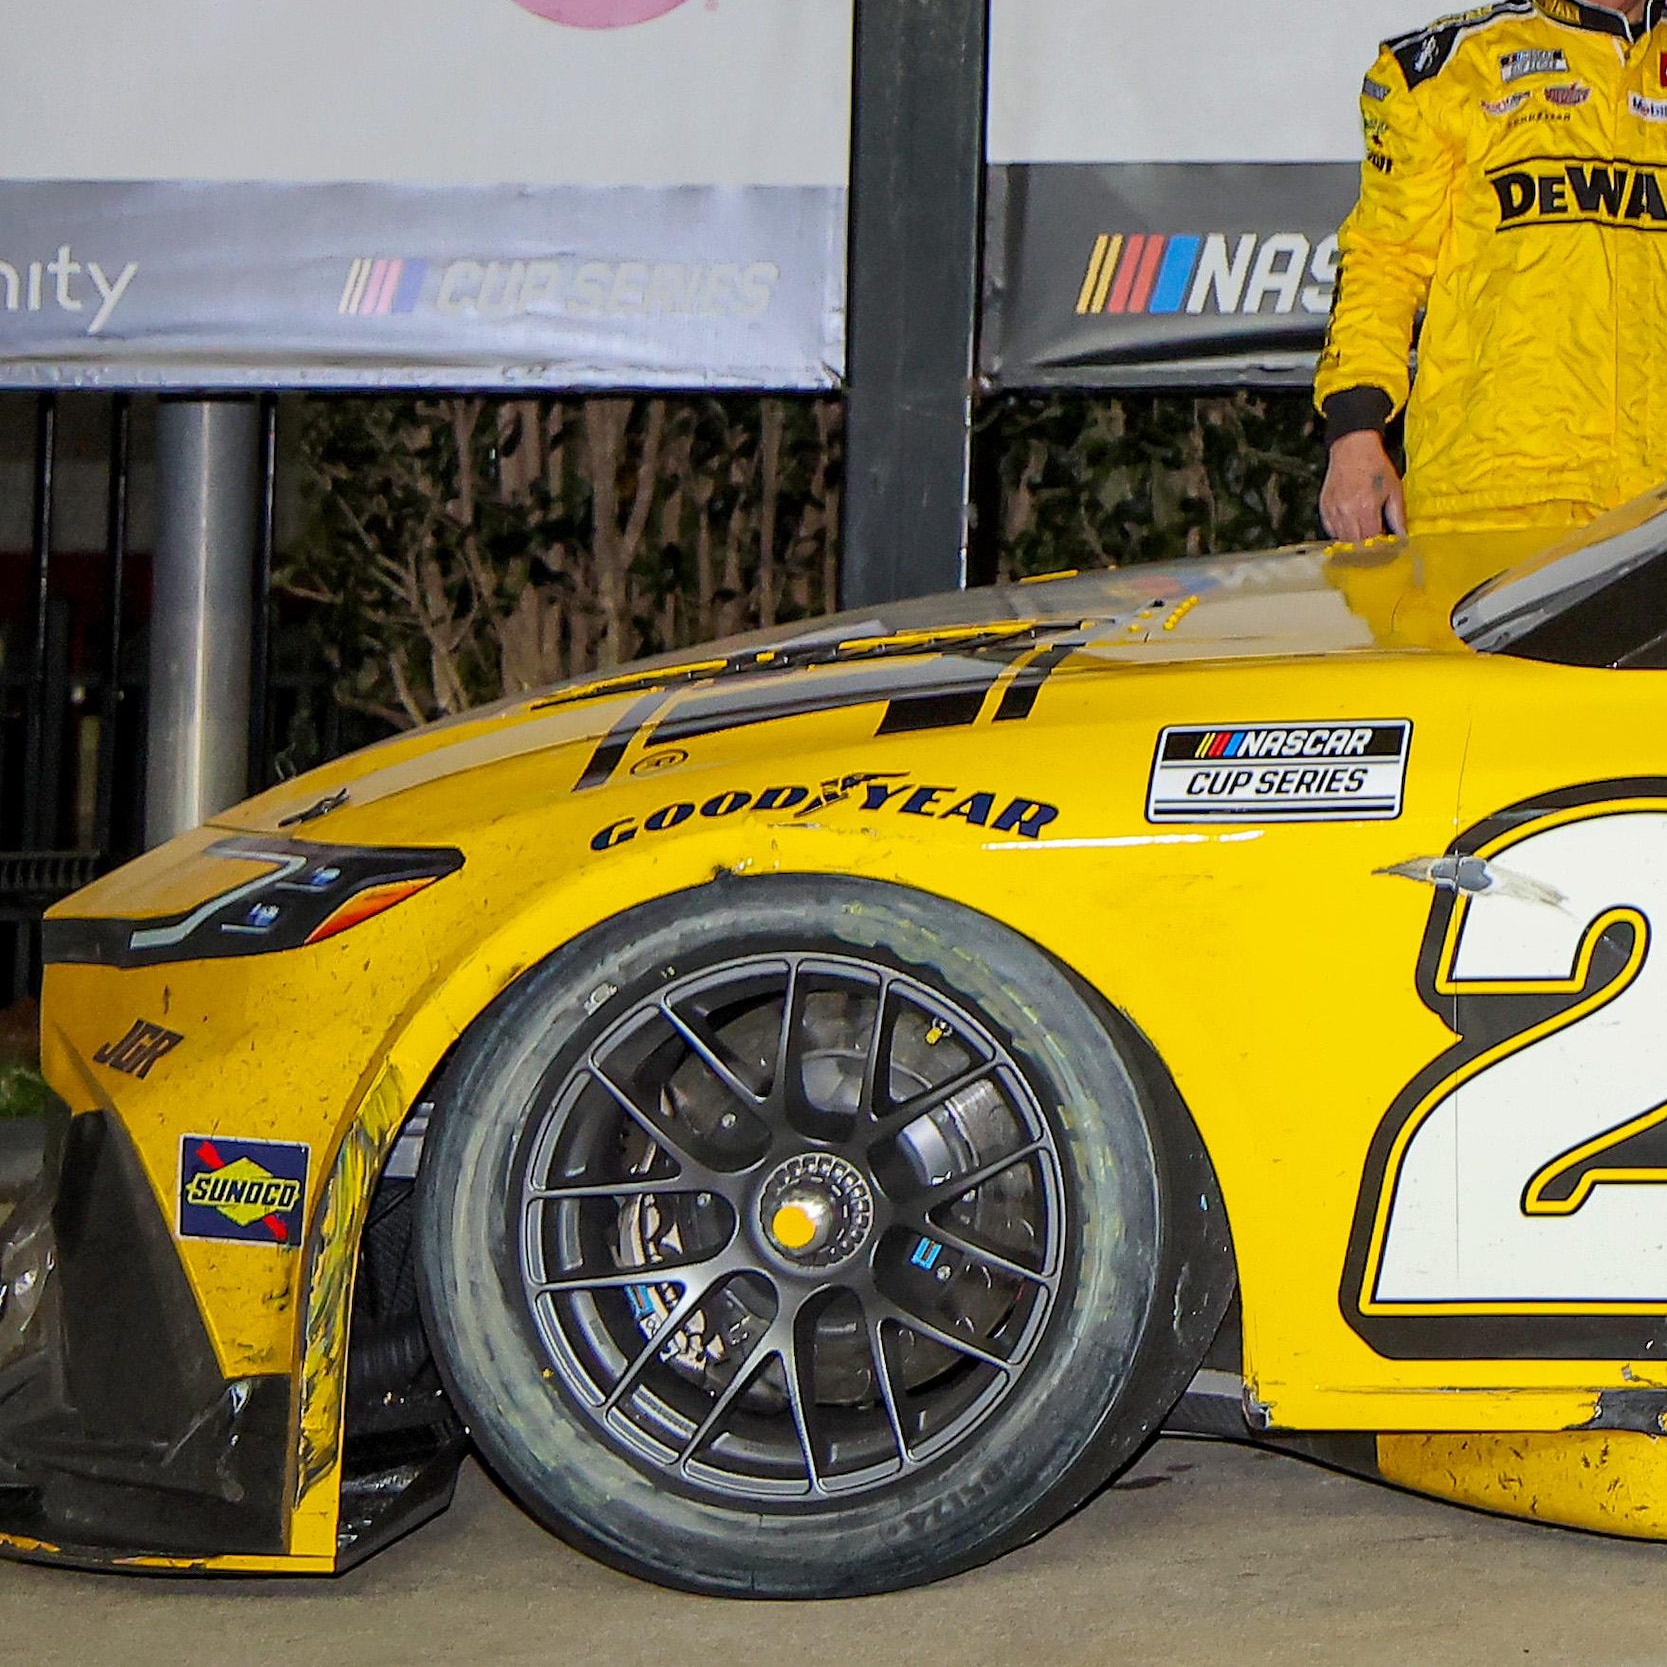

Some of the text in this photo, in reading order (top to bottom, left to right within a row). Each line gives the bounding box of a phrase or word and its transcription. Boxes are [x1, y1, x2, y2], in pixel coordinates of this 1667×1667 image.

[436, 259, 780, 316] CUP SERIES
[1239, 727, 1374, 758] NASCAR
[1184, 766, 1369, 797] CUP SERIES
[589, 770, 1059, 853] GOODYEAR
[92, 1018, 184, 1080] JGR
[190, 1175, 300, 1211] SUNOCO
